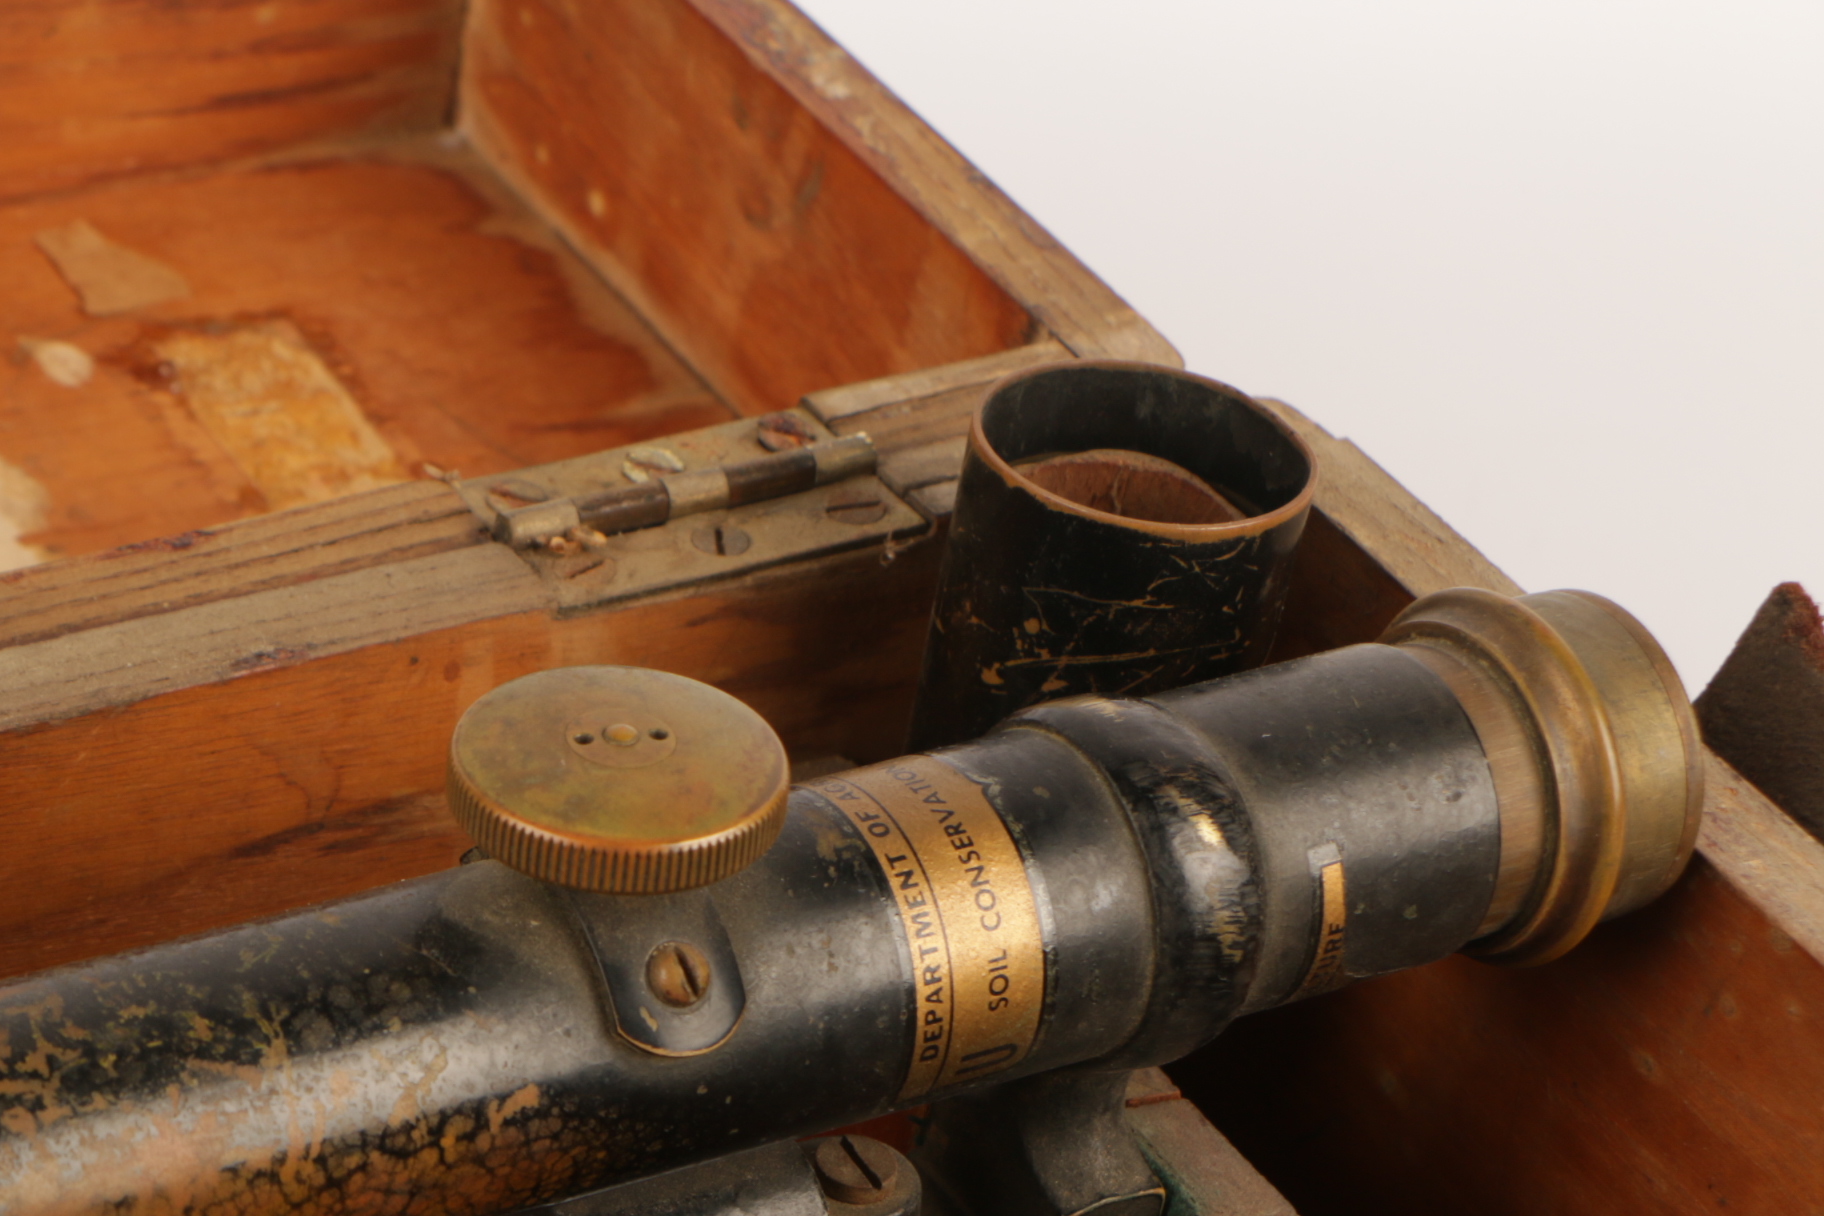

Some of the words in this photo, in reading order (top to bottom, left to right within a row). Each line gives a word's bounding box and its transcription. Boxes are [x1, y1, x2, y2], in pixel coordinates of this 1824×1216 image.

[854, 809, 891, 839] OF
[885, 765, 1001, 931] CONSERVATION
[884, 851, 944, 1063] DEPARTMENT
[987, 948, 1010, 1012] SOIL
